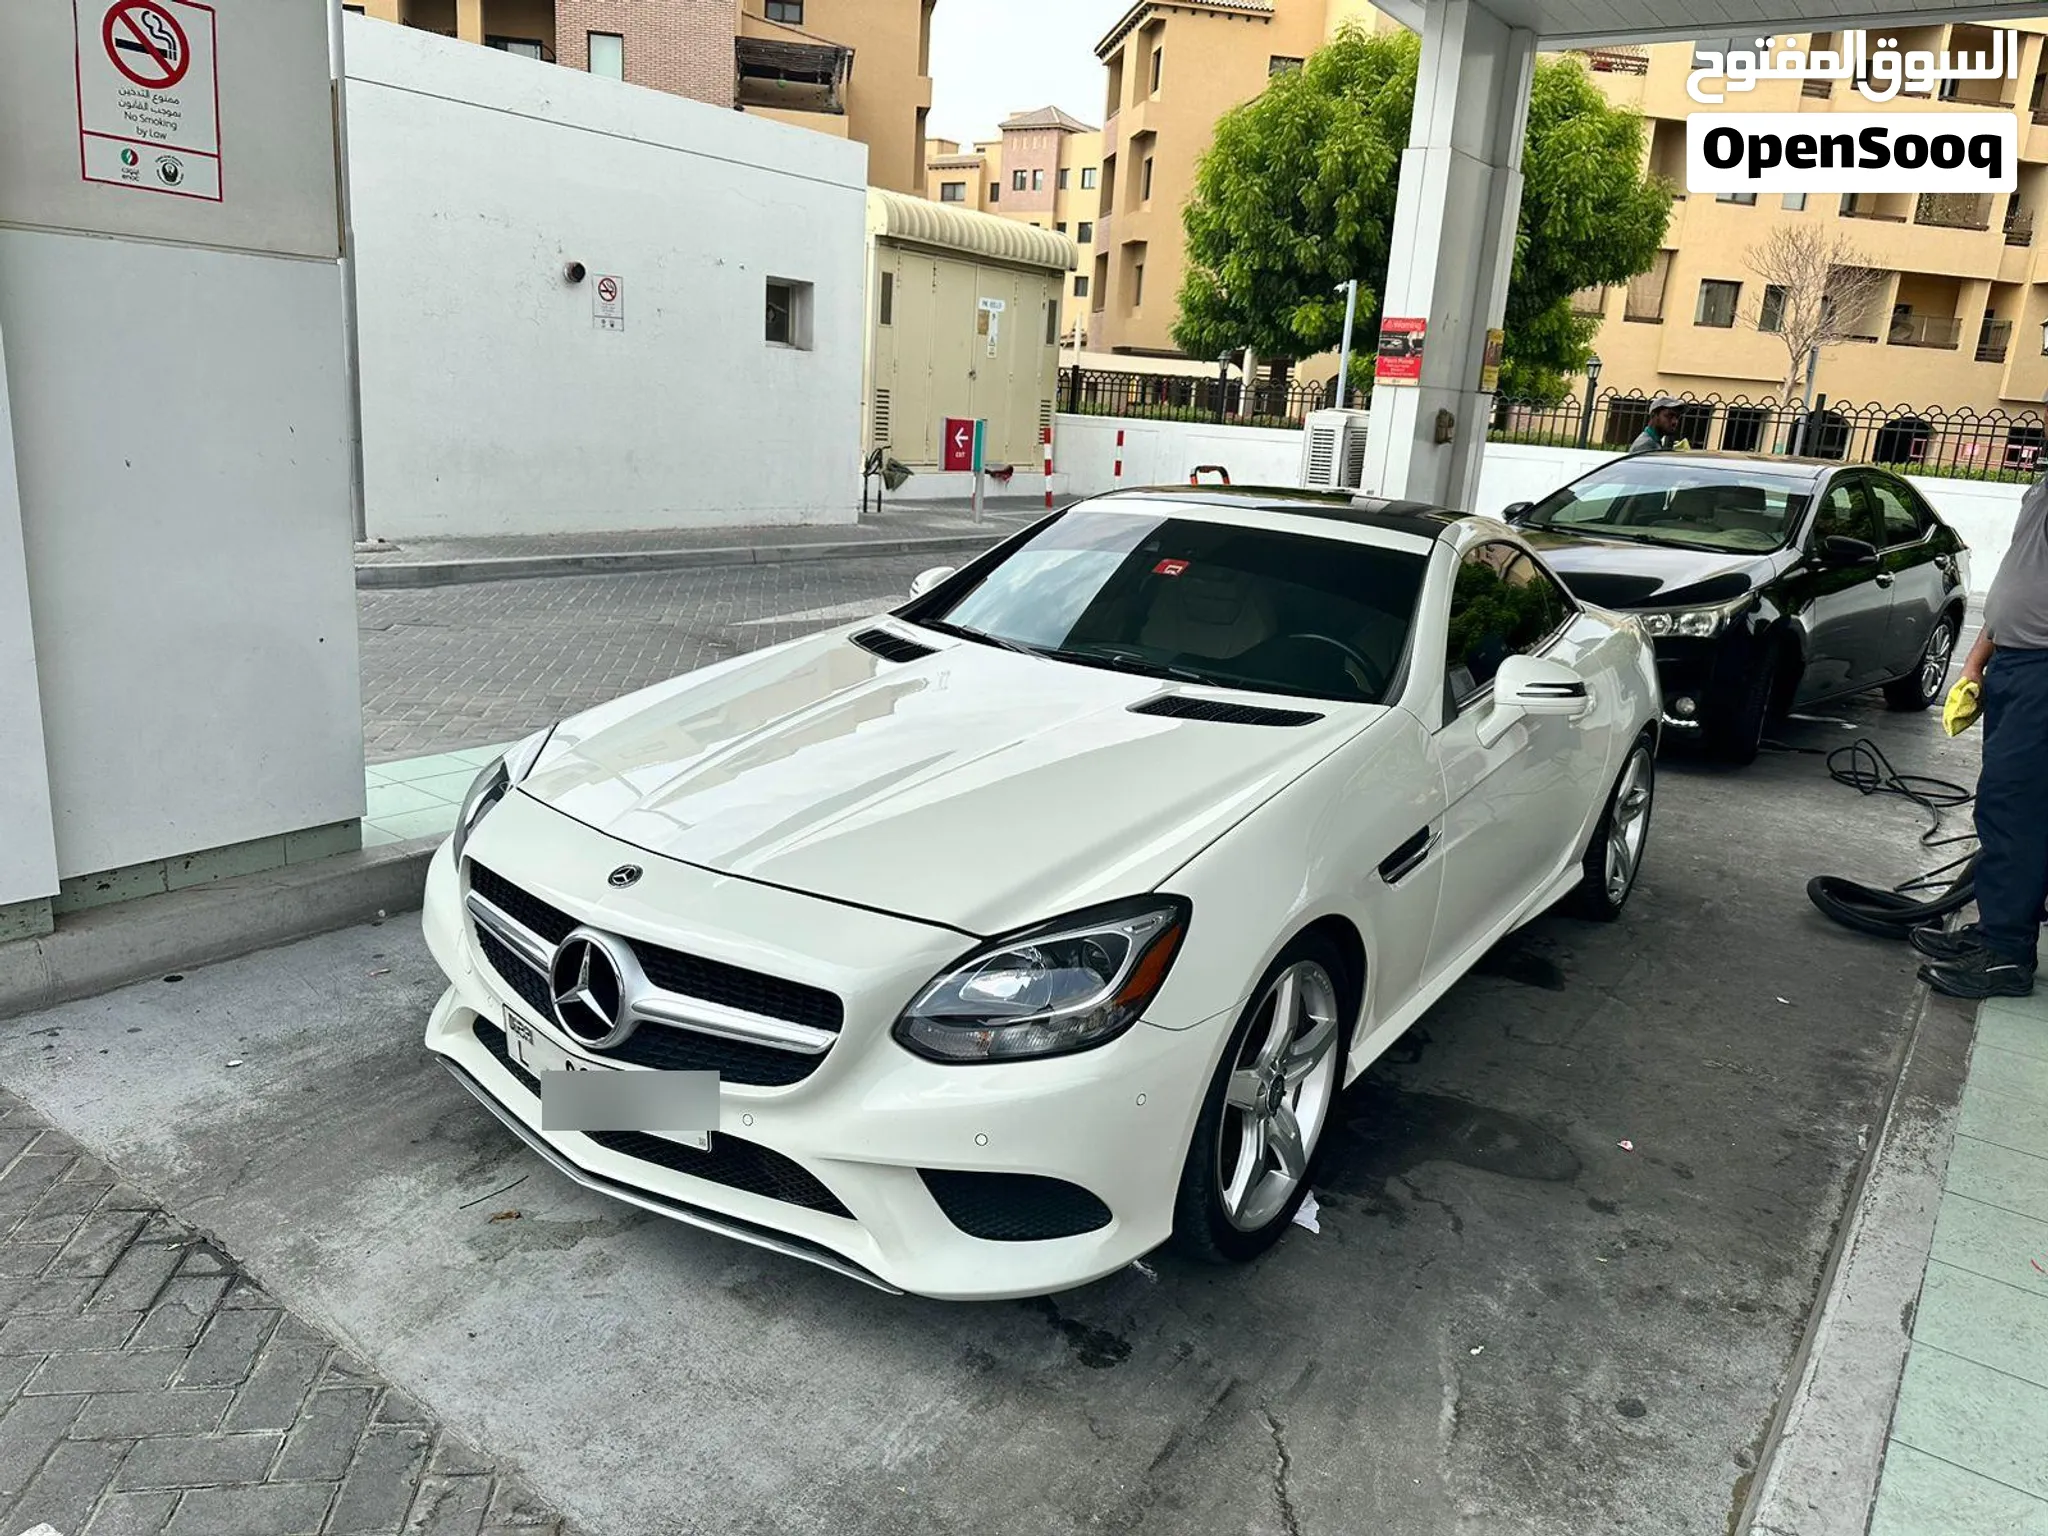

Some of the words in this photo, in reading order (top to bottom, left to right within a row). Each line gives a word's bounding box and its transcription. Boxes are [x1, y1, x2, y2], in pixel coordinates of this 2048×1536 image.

[118, 88, 149, 98] التدخين
[152, 94, 180, 105] ممنوع
[150, 107, 182, 118] بموجب
[124, 110, 138, 122] No
[139, 113, 178, 132] Smoking
[136, 126, 148, 138] by
[149, 128, 167, 140] Law
